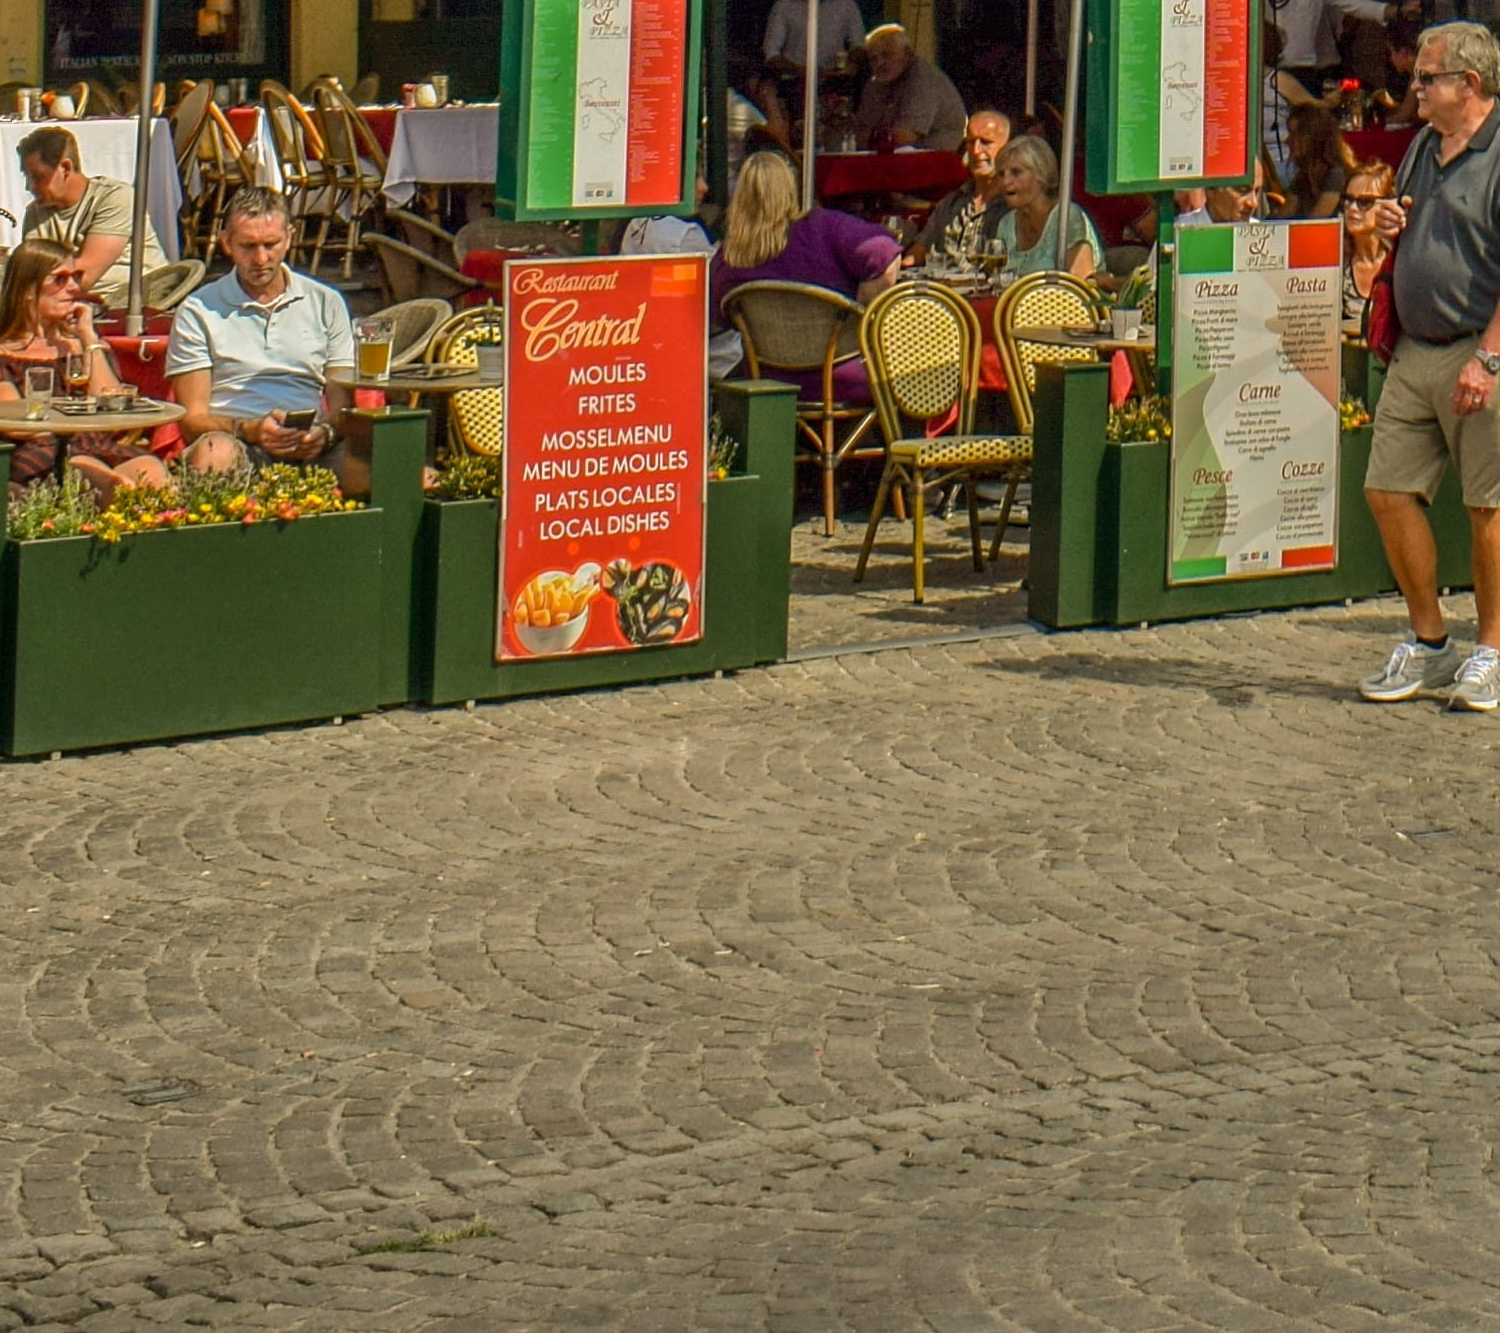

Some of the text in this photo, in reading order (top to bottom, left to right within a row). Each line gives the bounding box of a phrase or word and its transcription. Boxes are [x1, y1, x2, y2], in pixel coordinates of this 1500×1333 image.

[513, 269, 618, 295] Restaurant
[1195, 280, 1238, 298] Pizza
[1286, 277, 1326, 294] Pasta
[521, 298, 647, 361] Central
[569, 363, 645, 385] MOULES
[1239, 383, 1281, 402] Carne
[578, 393, 636, 415] FRITES
[541, 424, 672, 451] MOSSELMENU
[523, 450, 689, 481] MENU DE MOULES
[1193, 467, 1233, 485] Pesce
[1282, 460, 1325, 480] Cozze
[535, 483, 676, 512] PLATS LOCALES
[540, 511, 670, 541] LOCAL DISHES
